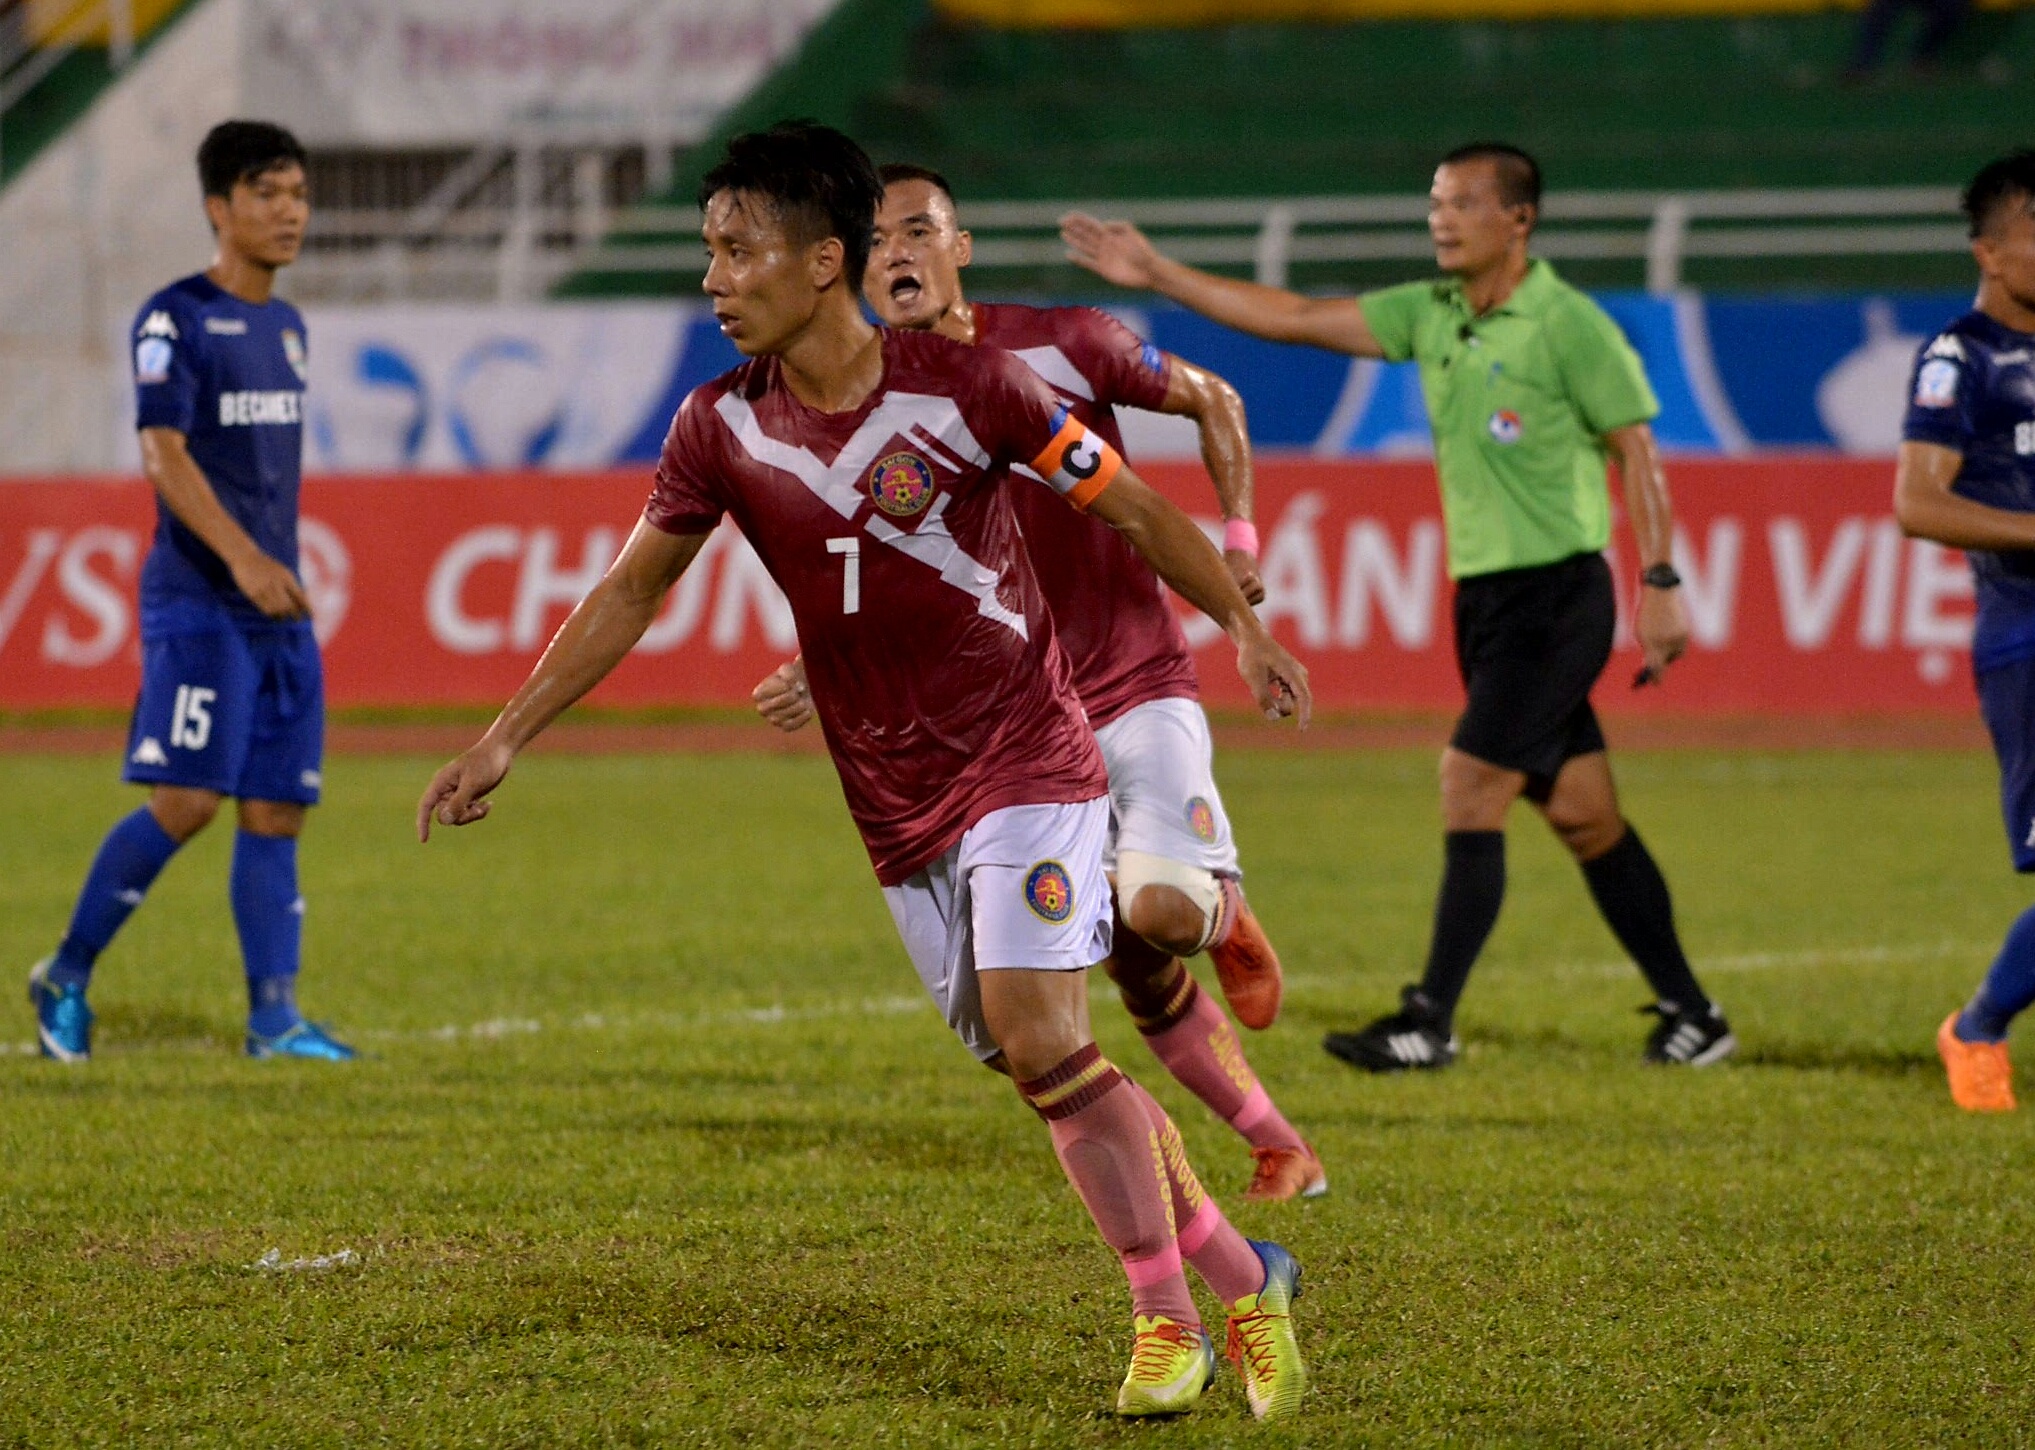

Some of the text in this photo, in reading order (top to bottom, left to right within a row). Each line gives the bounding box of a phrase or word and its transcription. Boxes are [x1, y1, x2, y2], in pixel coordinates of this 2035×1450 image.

[1061, 440, 1101, 479] C
[826, 537, 859, 614] 7
[170, 684, 216, 750] 15
